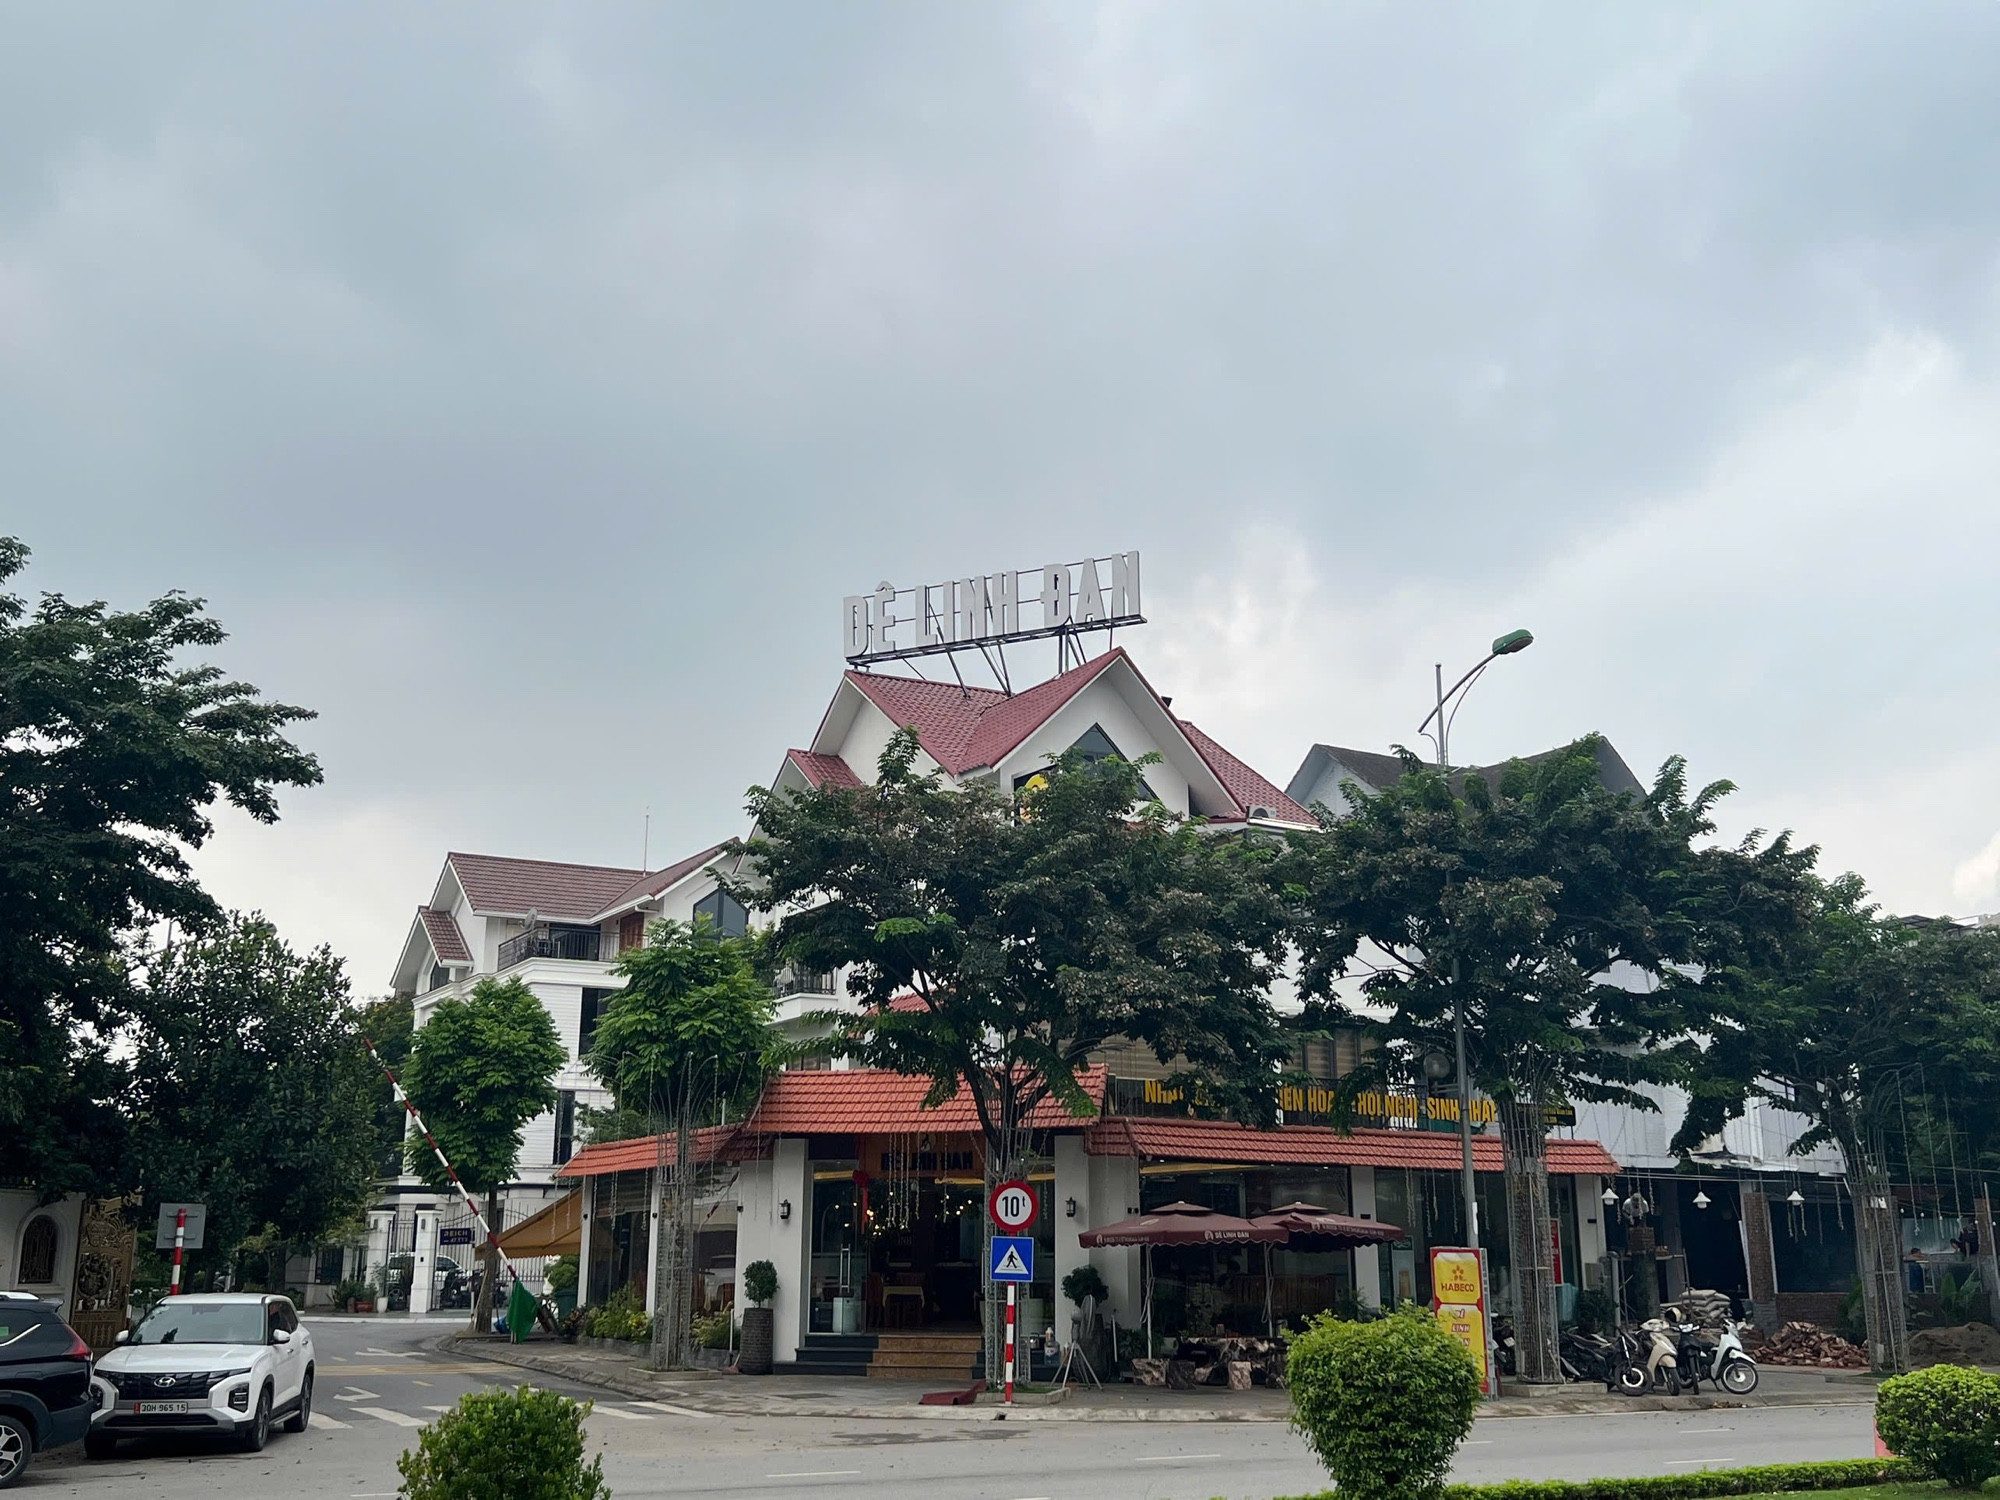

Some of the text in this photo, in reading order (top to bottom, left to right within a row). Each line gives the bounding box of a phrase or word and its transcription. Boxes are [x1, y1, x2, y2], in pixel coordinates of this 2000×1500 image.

[843, 550, 1140, 658] DÊ LINH ĐAN
[1426, 1097, 1460, 1121] SINH
[1441, 1282, 1475, 1293] HABECO
[141, 1404, 156, 1412] 30H
